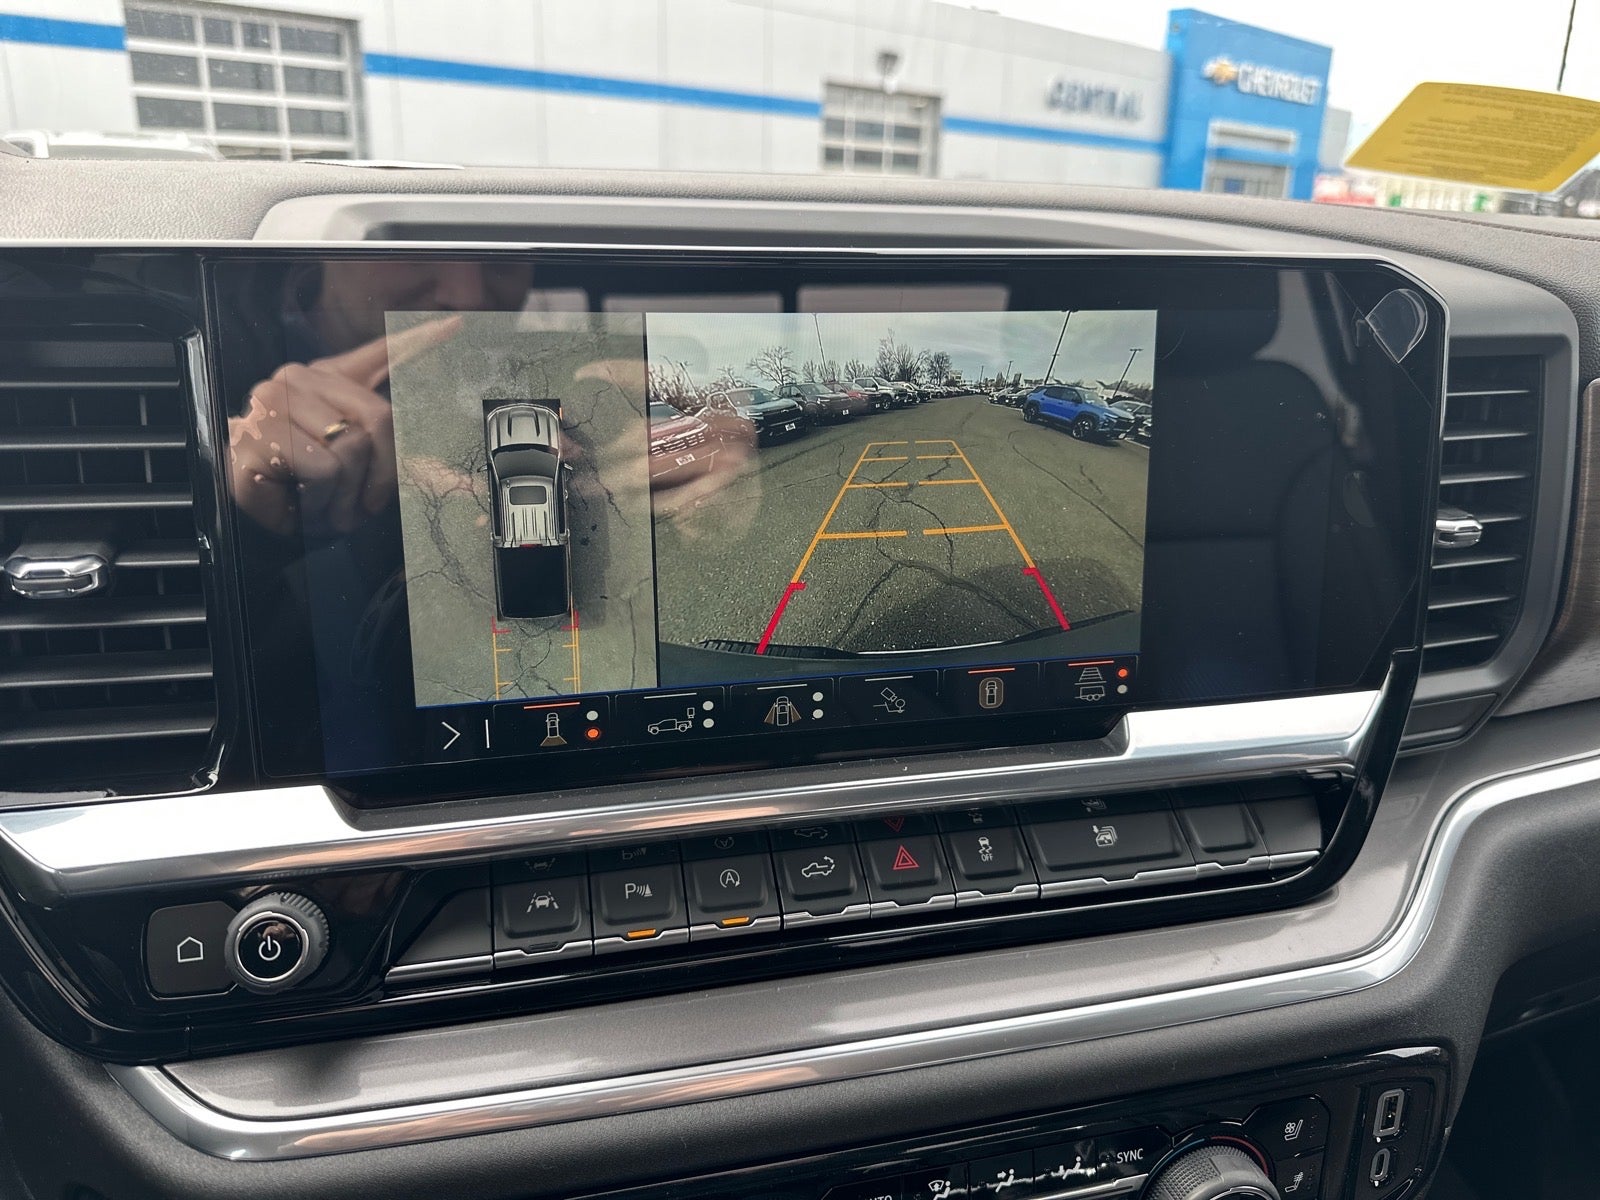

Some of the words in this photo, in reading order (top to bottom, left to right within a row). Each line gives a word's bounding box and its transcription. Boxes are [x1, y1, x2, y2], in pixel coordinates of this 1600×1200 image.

[1238, 63, 1322, 106] CHEVROLET
[1045, 79, 1142, 121] CENTRAL
[981, 853, 994, 862] OFF
[1116, 1148, 1144, 1164] SYNC
